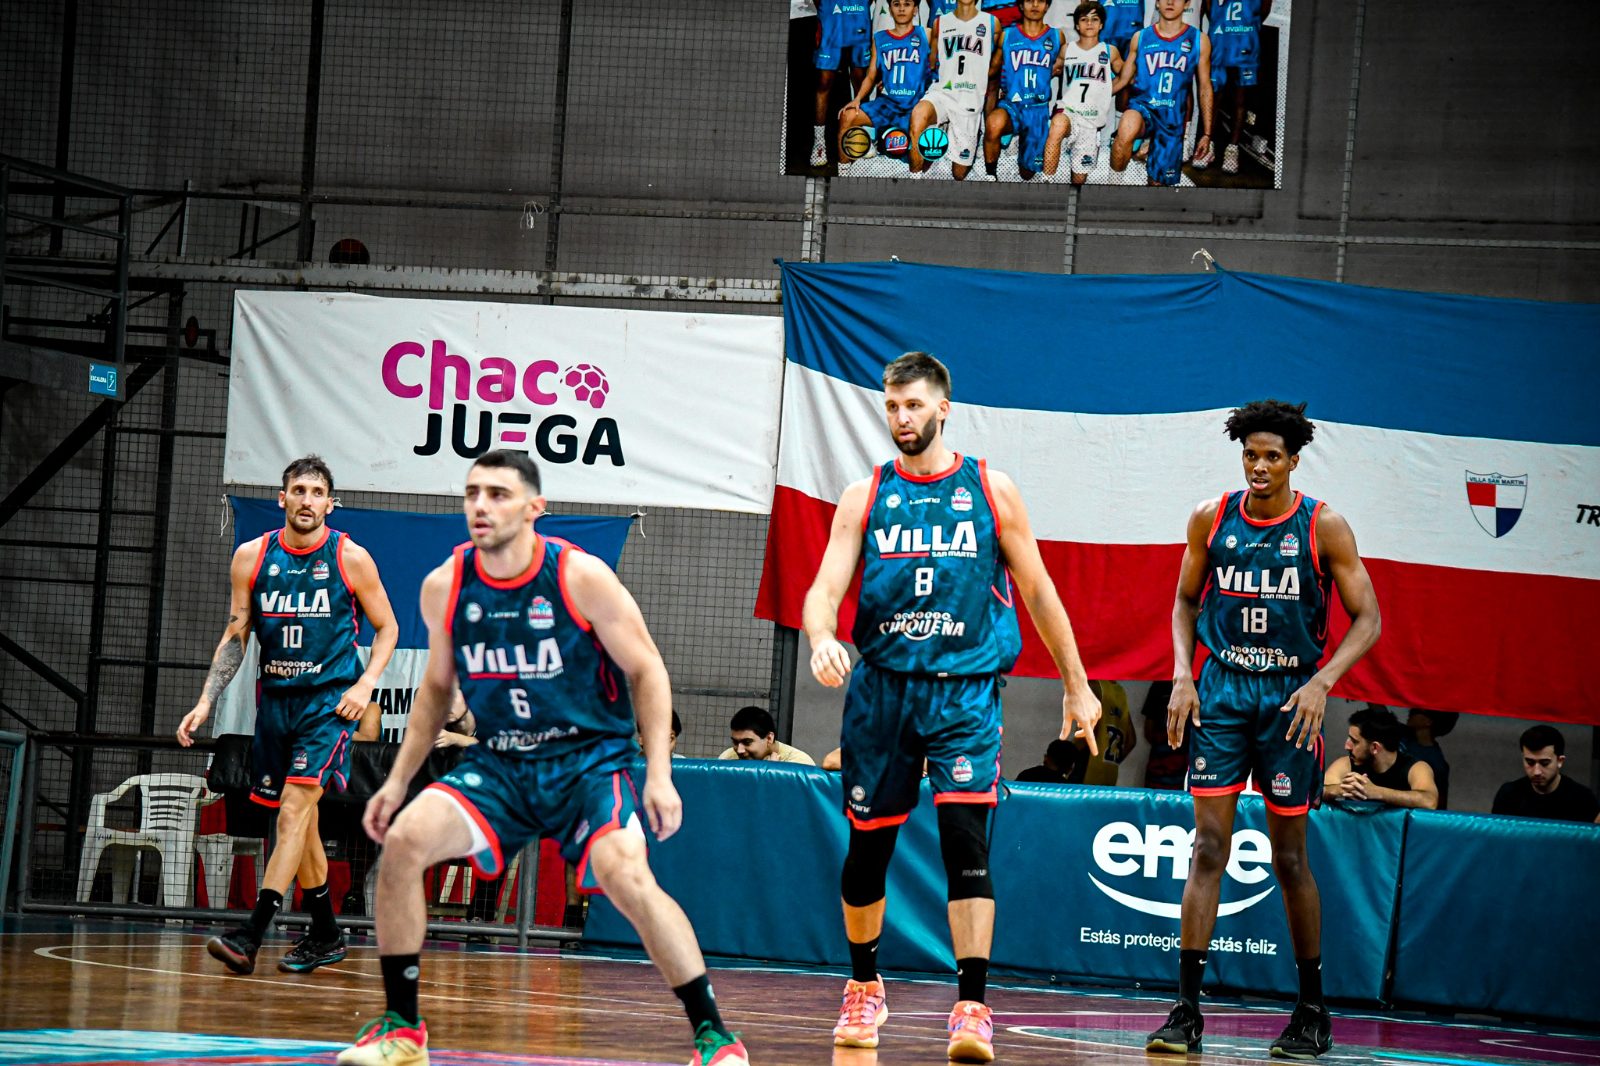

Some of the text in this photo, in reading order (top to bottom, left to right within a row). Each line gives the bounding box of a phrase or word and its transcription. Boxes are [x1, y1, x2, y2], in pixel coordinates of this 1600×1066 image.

[1226, 2, 1242, 21] 12
[883, 48, 919, 70] VILLA
[943, 34, 983, 60] VILLA
[957, 55, 966, 75] 6
[1011, 49, 1051, 72] VILLA
[1145, 51, 1187, 75] VILLA
[892, 65, 905, 84] 11
[1024, 69, 1037, 89] 14
[1065, 62, 1107, 87] VILLA
[1158, 72, 1174, 94] 13
[1080, 83, 1090, 103] 7
[413, 403, 625, 467] JUEGA
[874, 520, 978, 553] VILLA
[914, 567, 934, 597] 8
[1216, 565, 1300, 595] VILLA
[260, 588, 332, 613] VILLA
[1241, 606, 1268, 634] 18
[281, 625, 304, 649] 10
[461, 637, 564, 673] VILLA
[509, 688, 532, 720] 6
[1080, 927, 1121, 945] Estás
[1245, 939, 1277, 955] feliz
